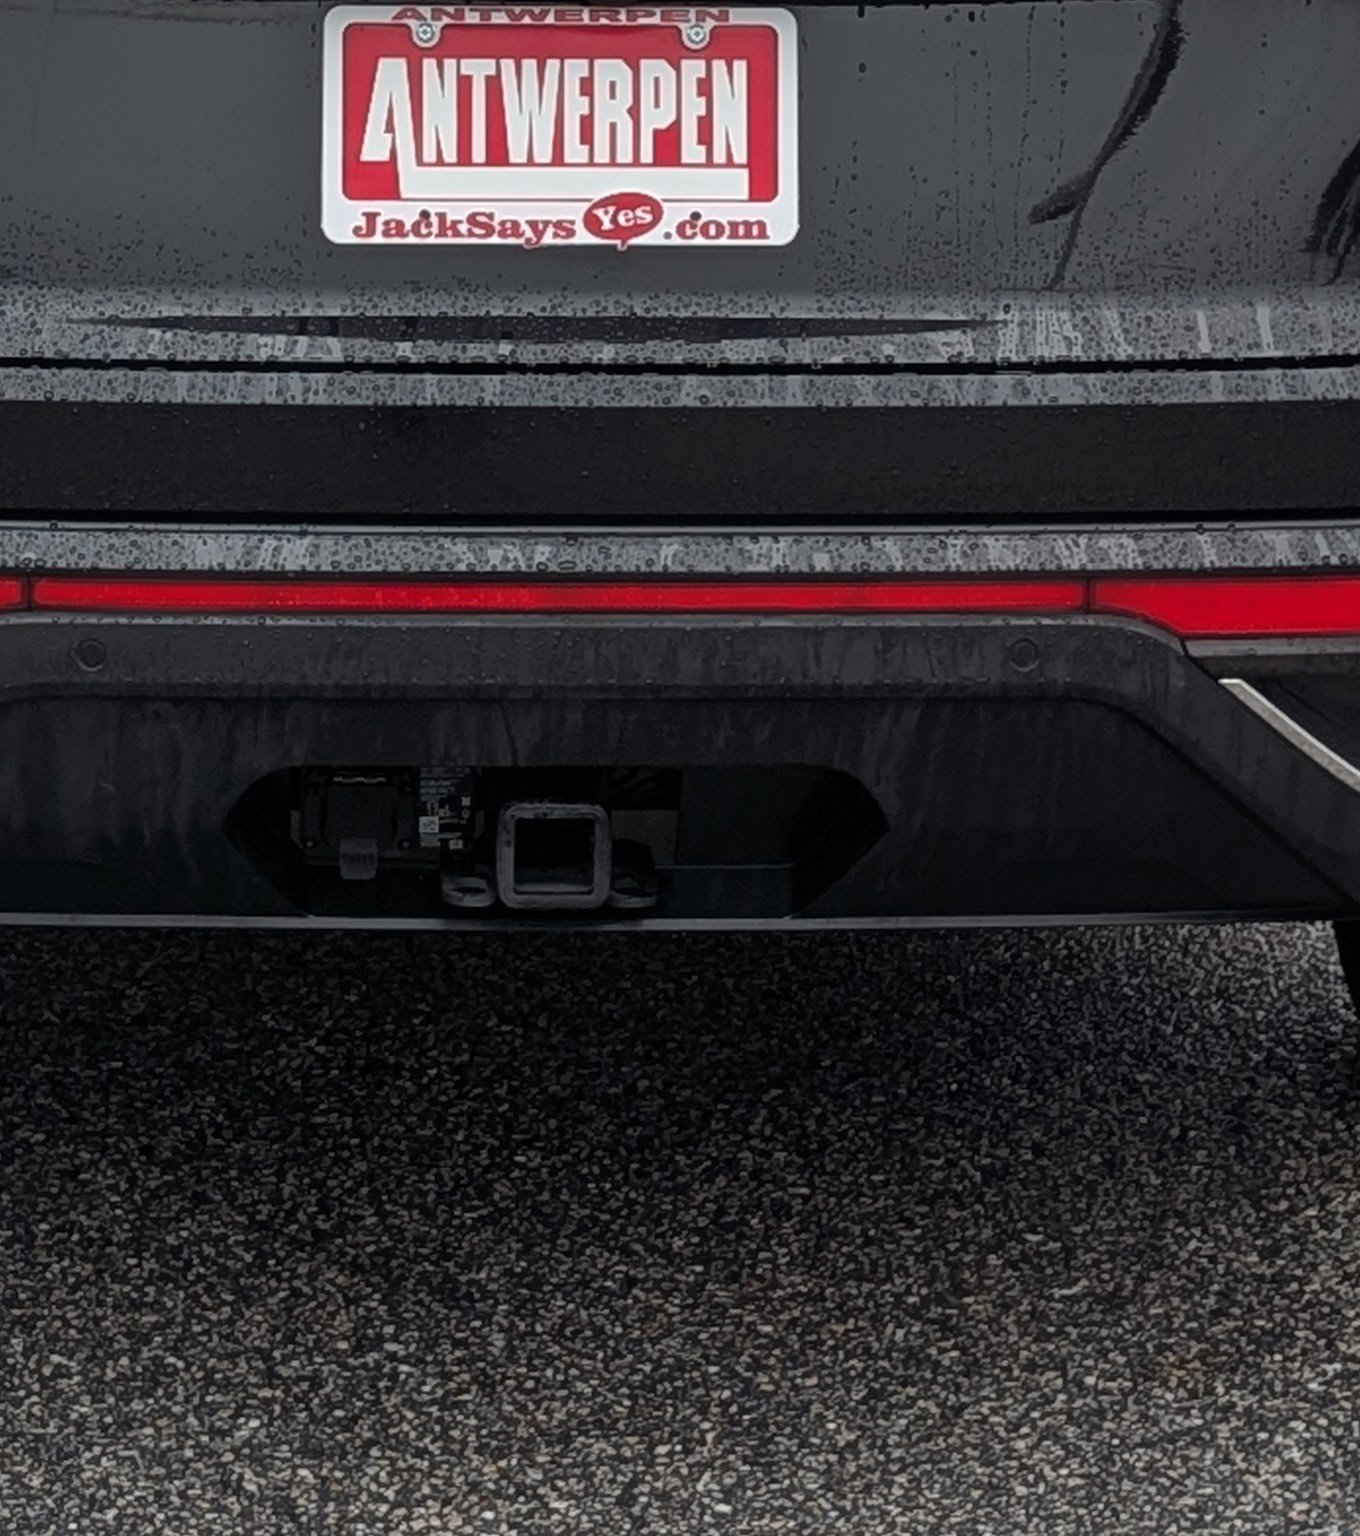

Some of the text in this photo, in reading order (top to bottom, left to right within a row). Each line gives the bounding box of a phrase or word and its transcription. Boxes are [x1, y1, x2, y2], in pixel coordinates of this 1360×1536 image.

[391, 6, 730, 23] ANTWERPEN
[359, 57, 748, 165] ANTWERPEN
[592, 205, 654, 231] Yes
